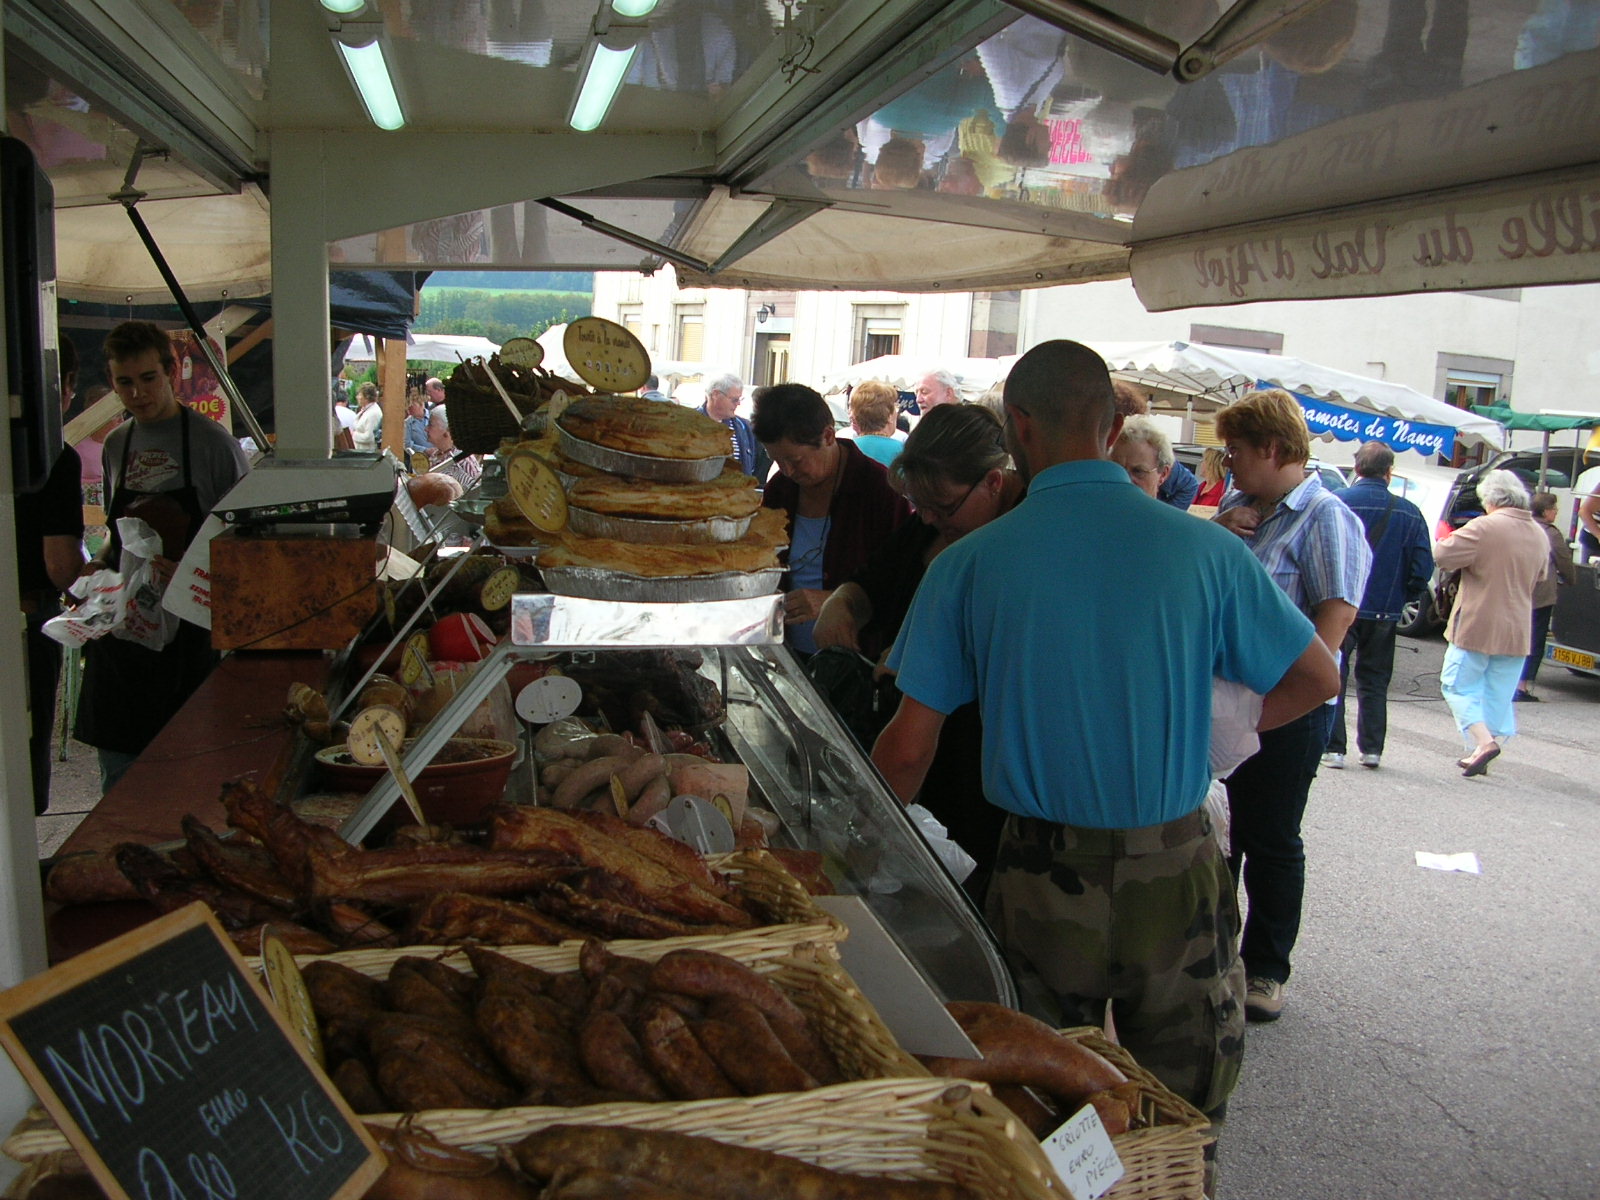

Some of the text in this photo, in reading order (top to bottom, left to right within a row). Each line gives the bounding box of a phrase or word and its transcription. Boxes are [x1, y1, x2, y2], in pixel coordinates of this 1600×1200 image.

[1364, 417, 1385, 437] de
[1392, 421, 1444, 452] Nancy
[198, 1087, 248, 1137] EURO
[258, 1090, 344, 1175] KG
